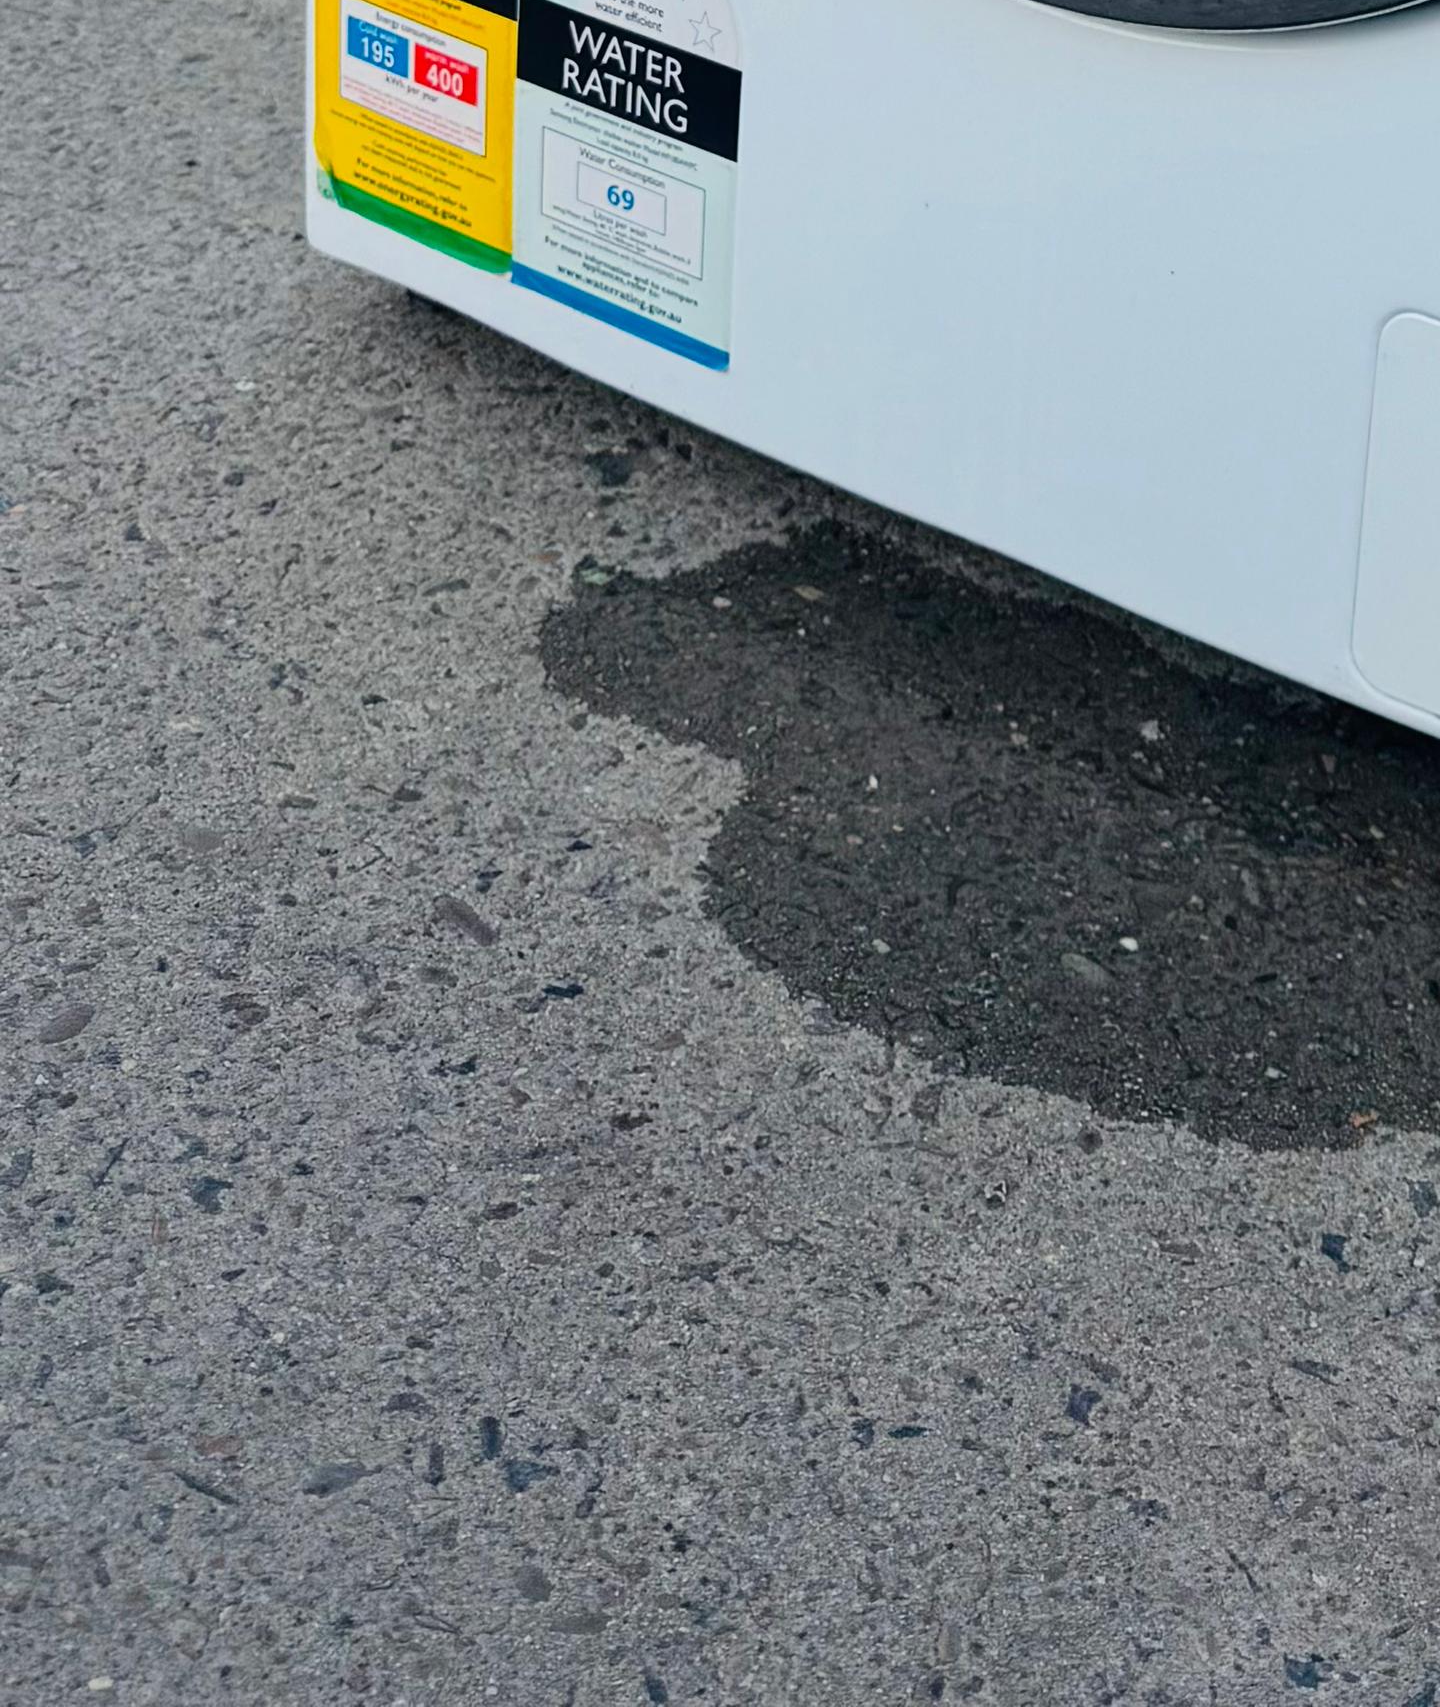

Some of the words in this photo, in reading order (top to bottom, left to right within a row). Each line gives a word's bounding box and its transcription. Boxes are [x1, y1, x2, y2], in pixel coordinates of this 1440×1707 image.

[595, 1, 623, 17] water
[625, 9, 663, 32] efficient
[638, 1, 664, 18] more
[360, 37, 395, 68] 195
[569, 19, 685, 94] WATER
[426, 64, 464, 97] 400
[562, 57, 688, 134] RATING
[579, 146, 605, 165] Water
[608, 159, 666, 188] Consumption
[607, 185, 635, 211] 69
[544, 235, 559, 248] For
[560, 243, 583, 258] more
[585, 251, 632, 279] information
[634, 273, 649, 288] and
[661, 284, 699, 307] compare
[557, 265, 683, 324] www.waterrating.gov.au
